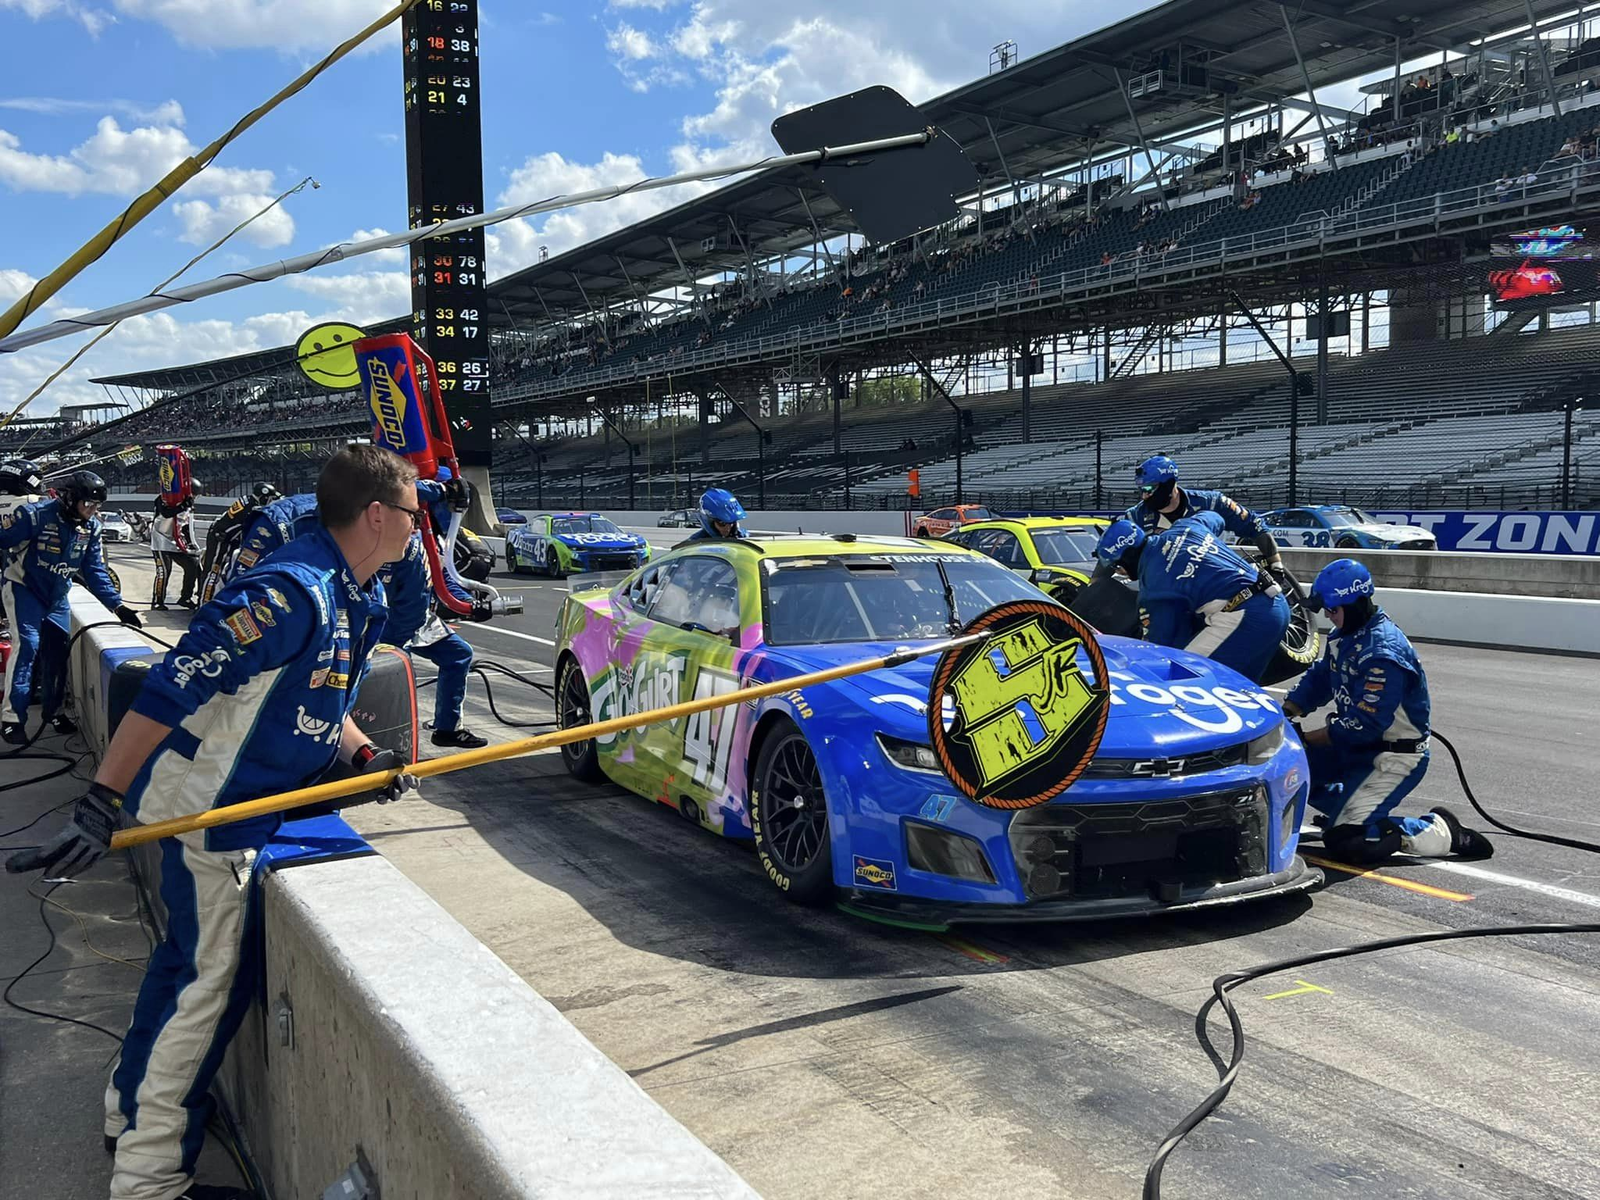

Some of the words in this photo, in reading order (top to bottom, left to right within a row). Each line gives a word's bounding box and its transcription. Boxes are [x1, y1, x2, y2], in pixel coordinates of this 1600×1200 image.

[427, 37, 444, 49] 18
[451, 39, 470, 52] 38
[452, 76, 471, 87] 23
[428, 91, 446, 104] 21
[456, 94, 468, 106] 4
[458, 256, 476, 268] 78
[434, 272, 452, 284] 31
[458, 273, 476, 286] 31
[436, 308, 454, 320] 33
[460, 309, 478, 320] 42
[436, 326, 455, 338] 34
[462, 326, 478, 338] 17
[438, 362, 456, 373] 36
[462, 362, 481, 374] 26
[439, 379, 456, 391] 37
[463, 380, 481, 392] 27
[369, 359, 405, 447] SUNOCO
[1456, 514, 1600, 553] ZON
[534, 539, 547, 562] 43
[870, 555, 970, 563] STENHOUSE
[684, 670, 739, 792] 47
[920, 794, 958, 822] 47
[856, 866, 894, 880] SUNOCO
